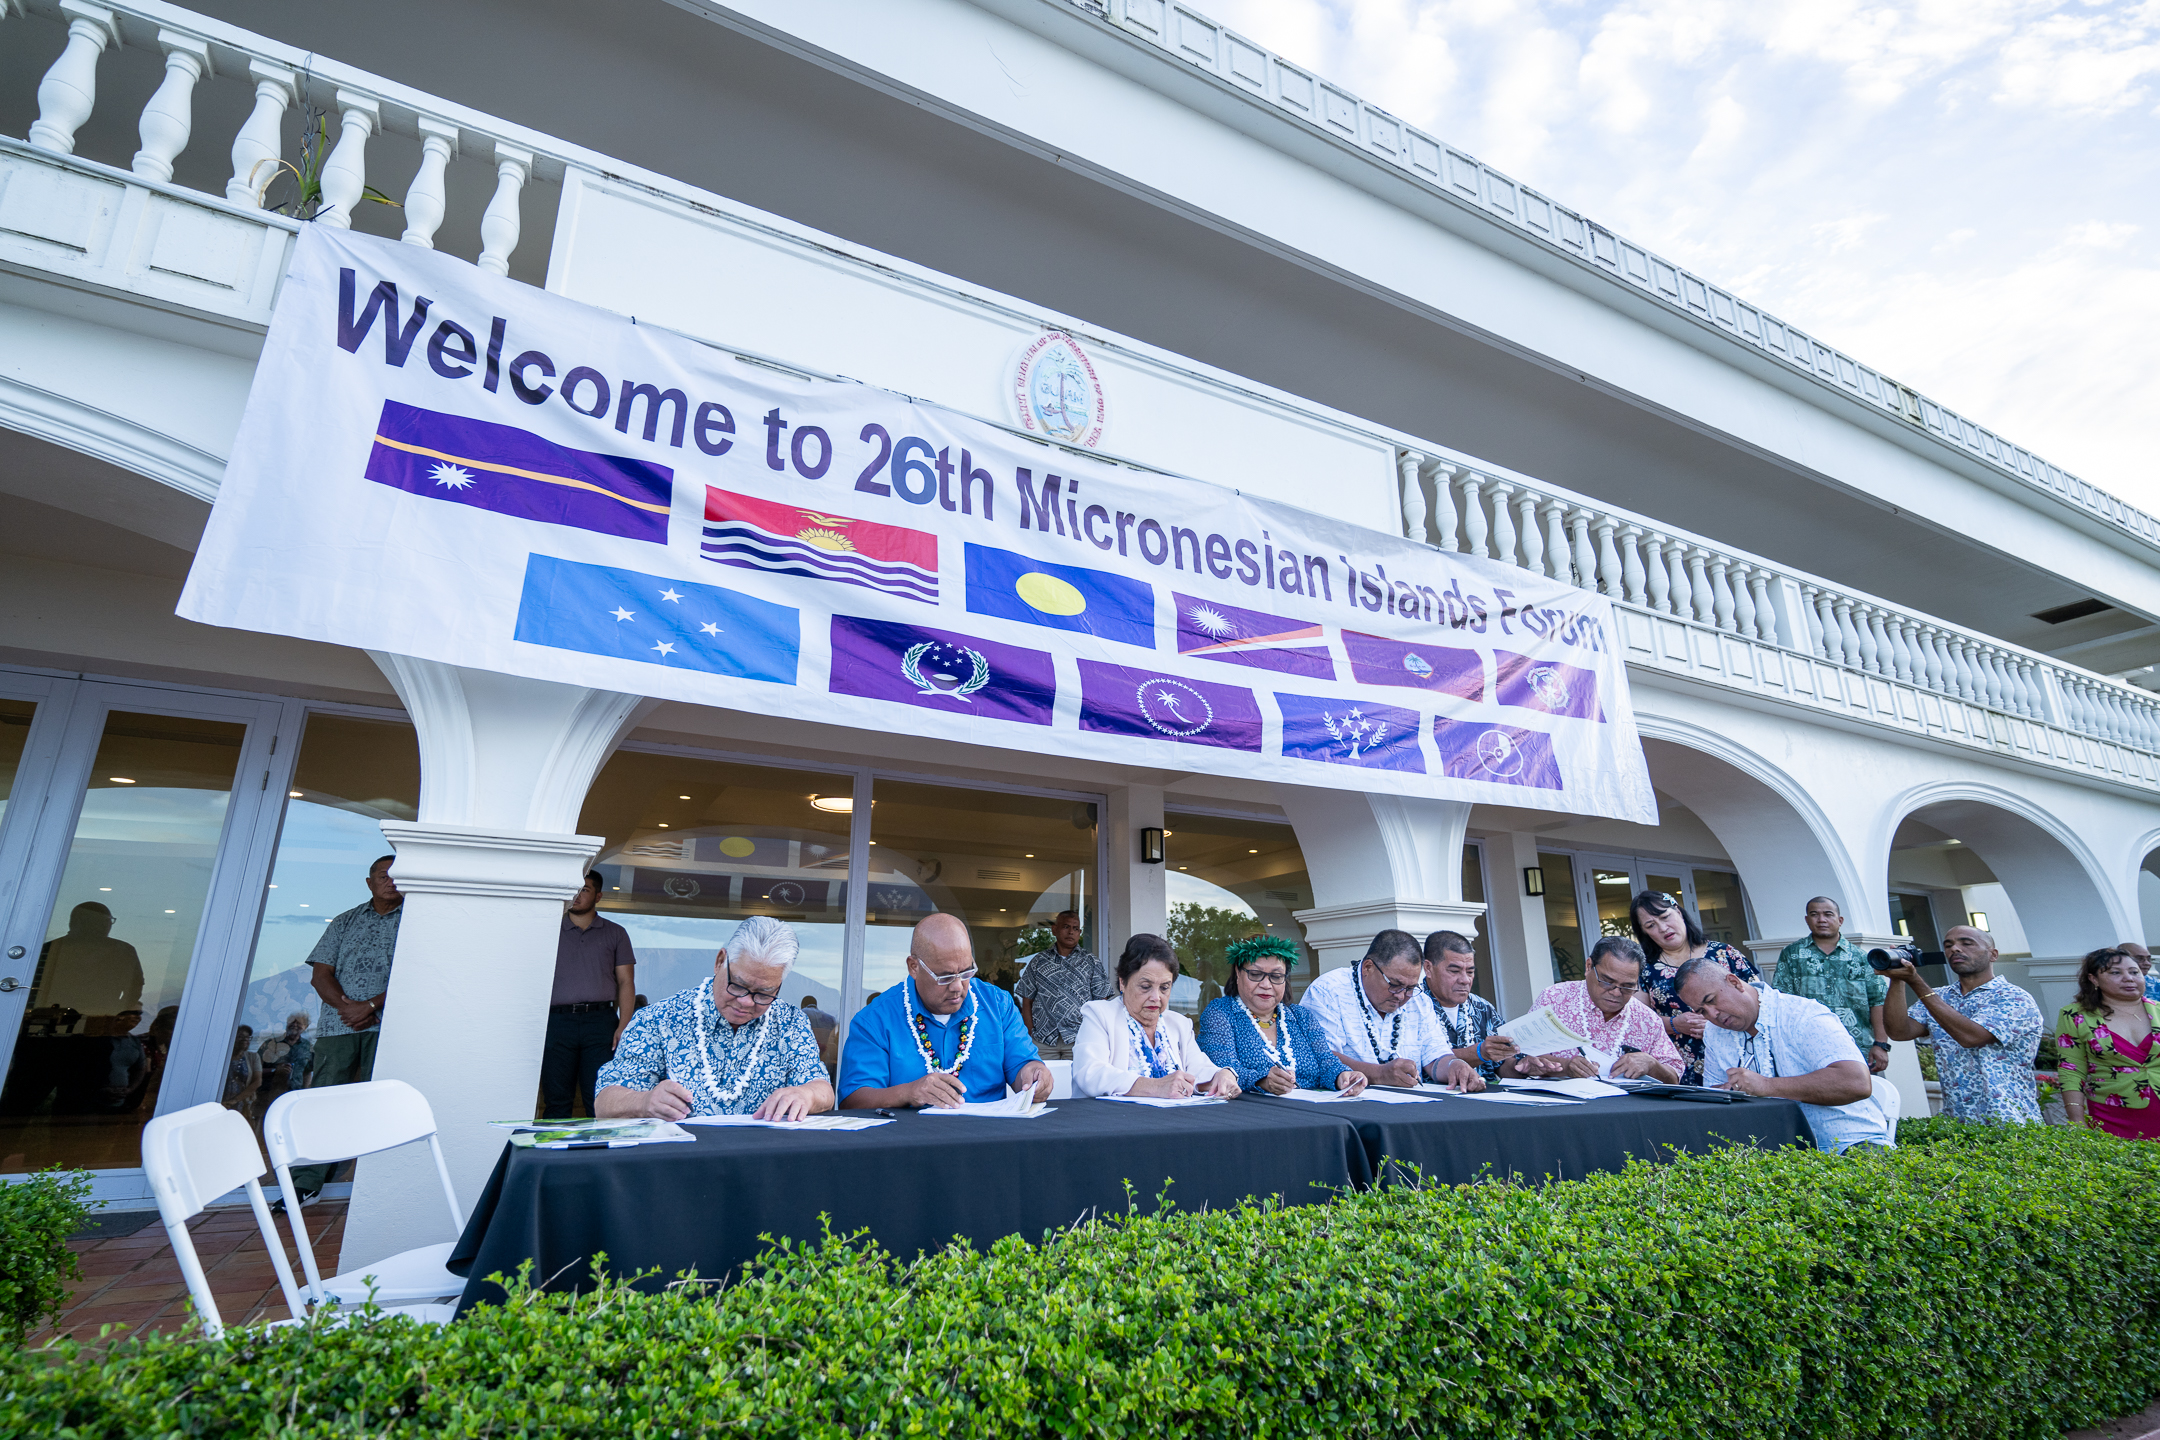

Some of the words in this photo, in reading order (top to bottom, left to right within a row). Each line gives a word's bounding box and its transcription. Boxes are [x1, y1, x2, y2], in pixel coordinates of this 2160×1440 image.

[337, 267, 736, 456] Welcome
[763, 407, 832, 480] to
[854, 423, 994, 521] 26th
[1015, 466, 1333, 601] Micronesian
[1339, 555, 1487, 634] Islands
[1493, 588, 1608, 654] Forum
[1040, 382, 1084, 405] GUAM
